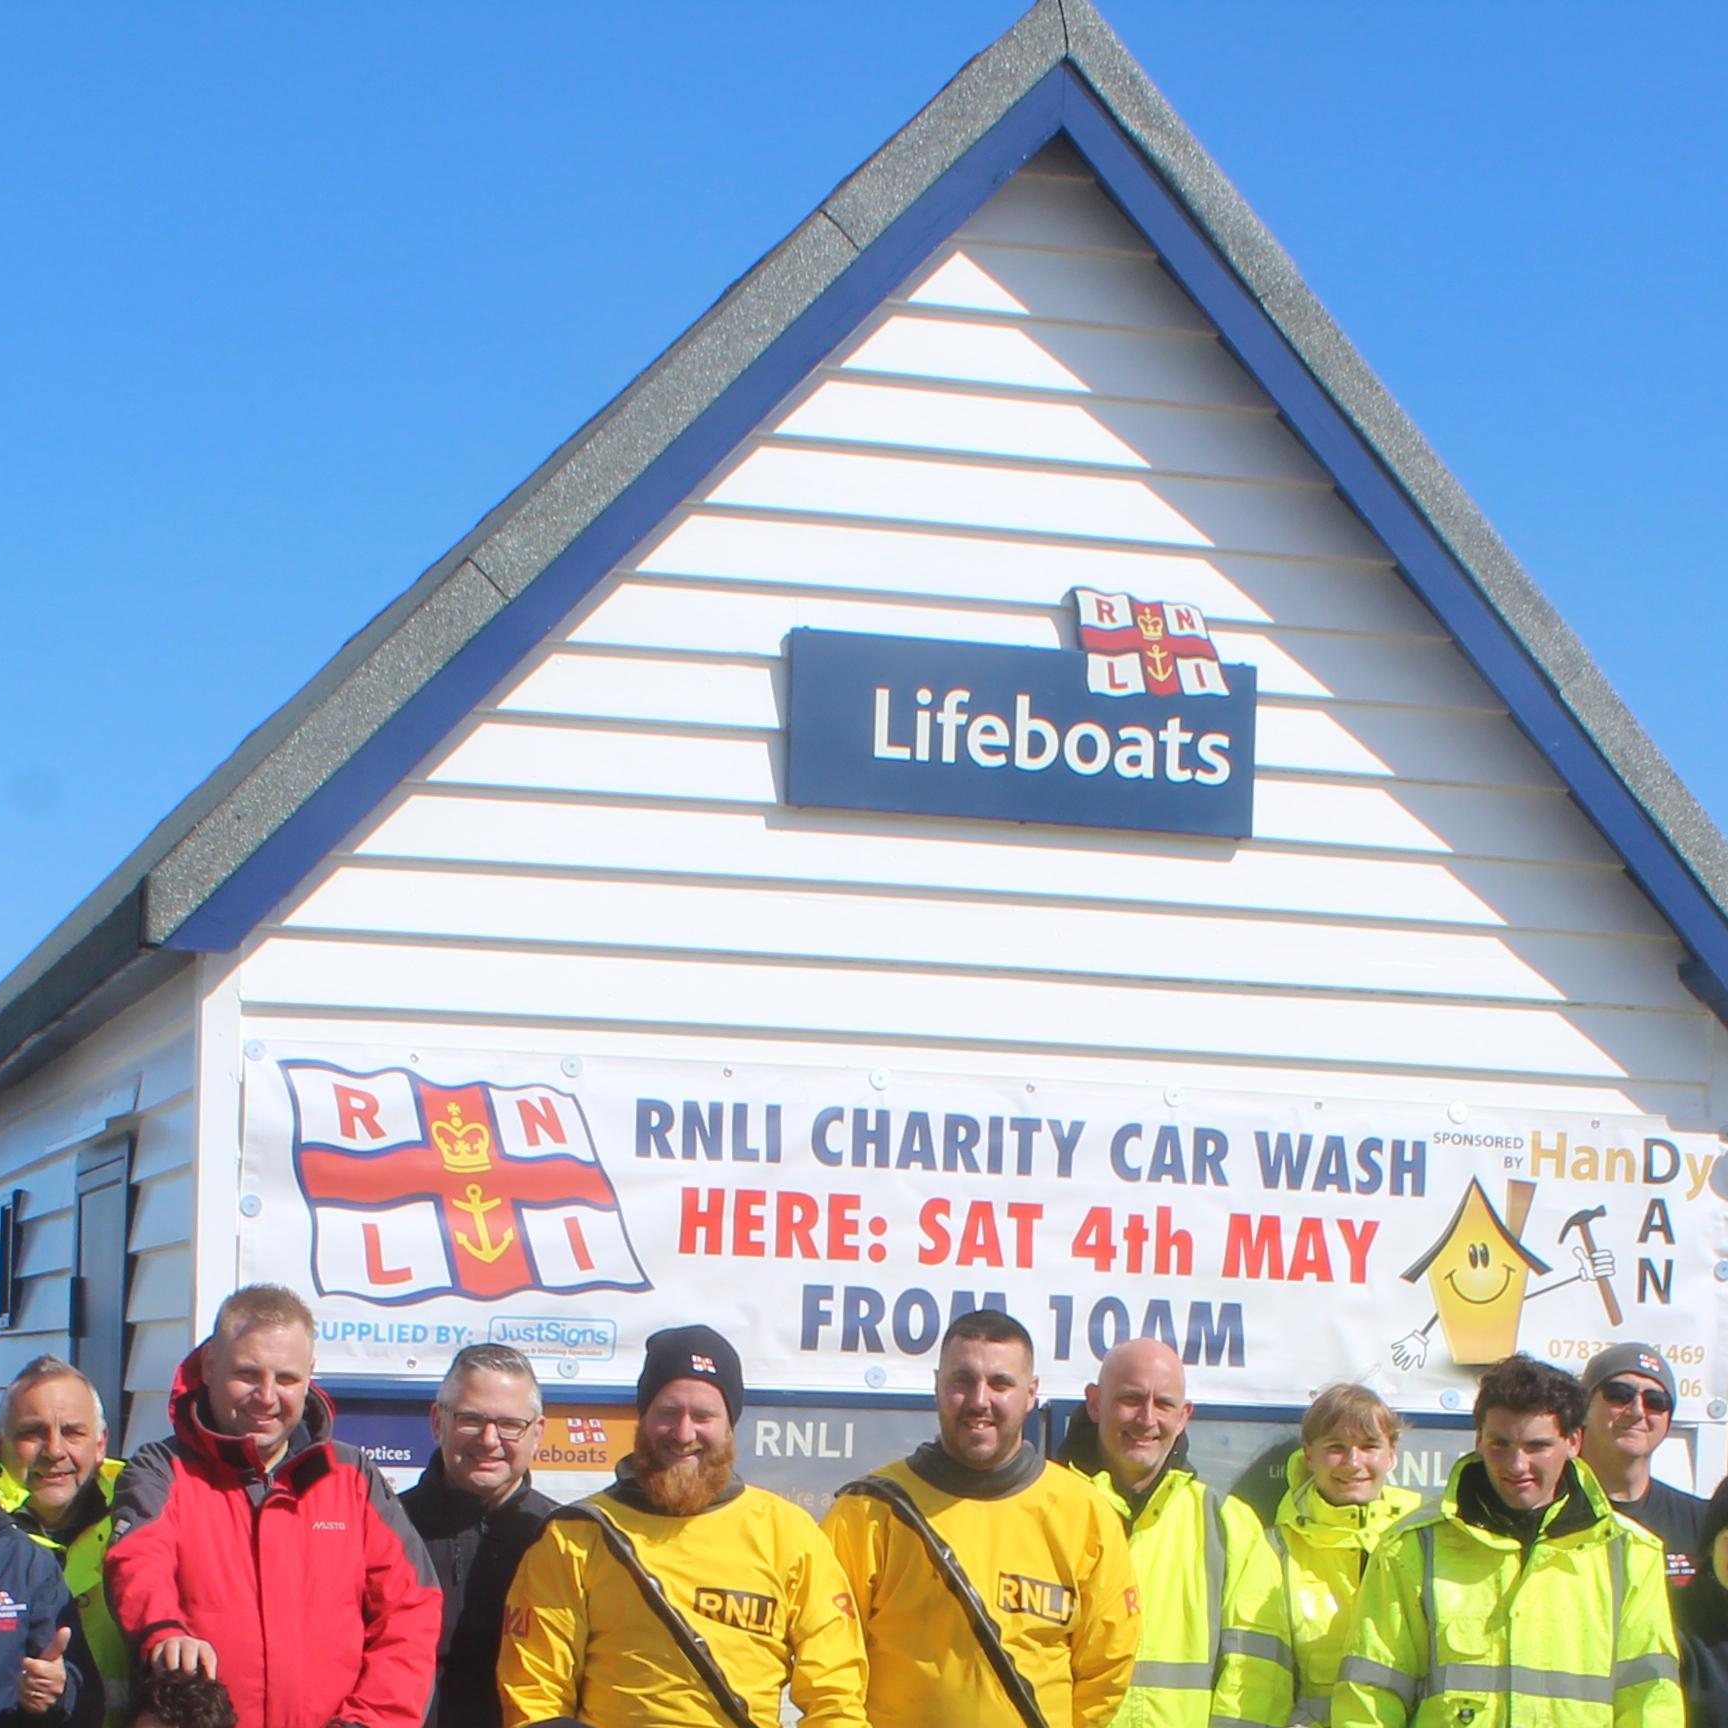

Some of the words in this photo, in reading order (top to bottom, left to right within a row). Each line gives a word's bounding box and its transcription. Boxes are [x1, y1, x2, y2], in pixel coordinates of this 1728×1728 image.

[1096, 598, 1117, 625] R
[1176, 609, 1197, 632] N
[1107, 661, 1129, 691] L
[872, 686, 1232, 786] Lifeboats
[333, 1083, 387, 1140] R
[517, 1096, 569, 1147] N
[635, 1098, 782, 1164] RNLI
[811, 1106, 1085, 1177] CHARITY
[1110, 1122, 1230, 1187] CAR
[1254, 1130, 1428, 1198] WASH
[1432, 1132, 1524, 1150] SPONSORED
[1503, 1156, 1523, 1170] BY
[363, 1223, 414, 1286] L
[562, 1216, 597, 1272] I
[678, 1186, 888, 1263] HERE:
[918, 1197, 1044, 1268] SAT
[1071, 1206, 1194, 1275] 4th
[1222, 1212, 1380, 1285] MAY
[436, 1324, 473, 1345] BY:
[496, 1322, 609, 1347] JustSigns
[1050, 1294, 1245, 1368] 10AM
[360, 1445, 413, 1461] otices
[754, 1419, 854, 1459] RNLI
[312, 1521, 347, 1531] MUSTO
[698, 1592, 775, 1634] RNLI
[998, 1575, 1072, 1622] RNLI
